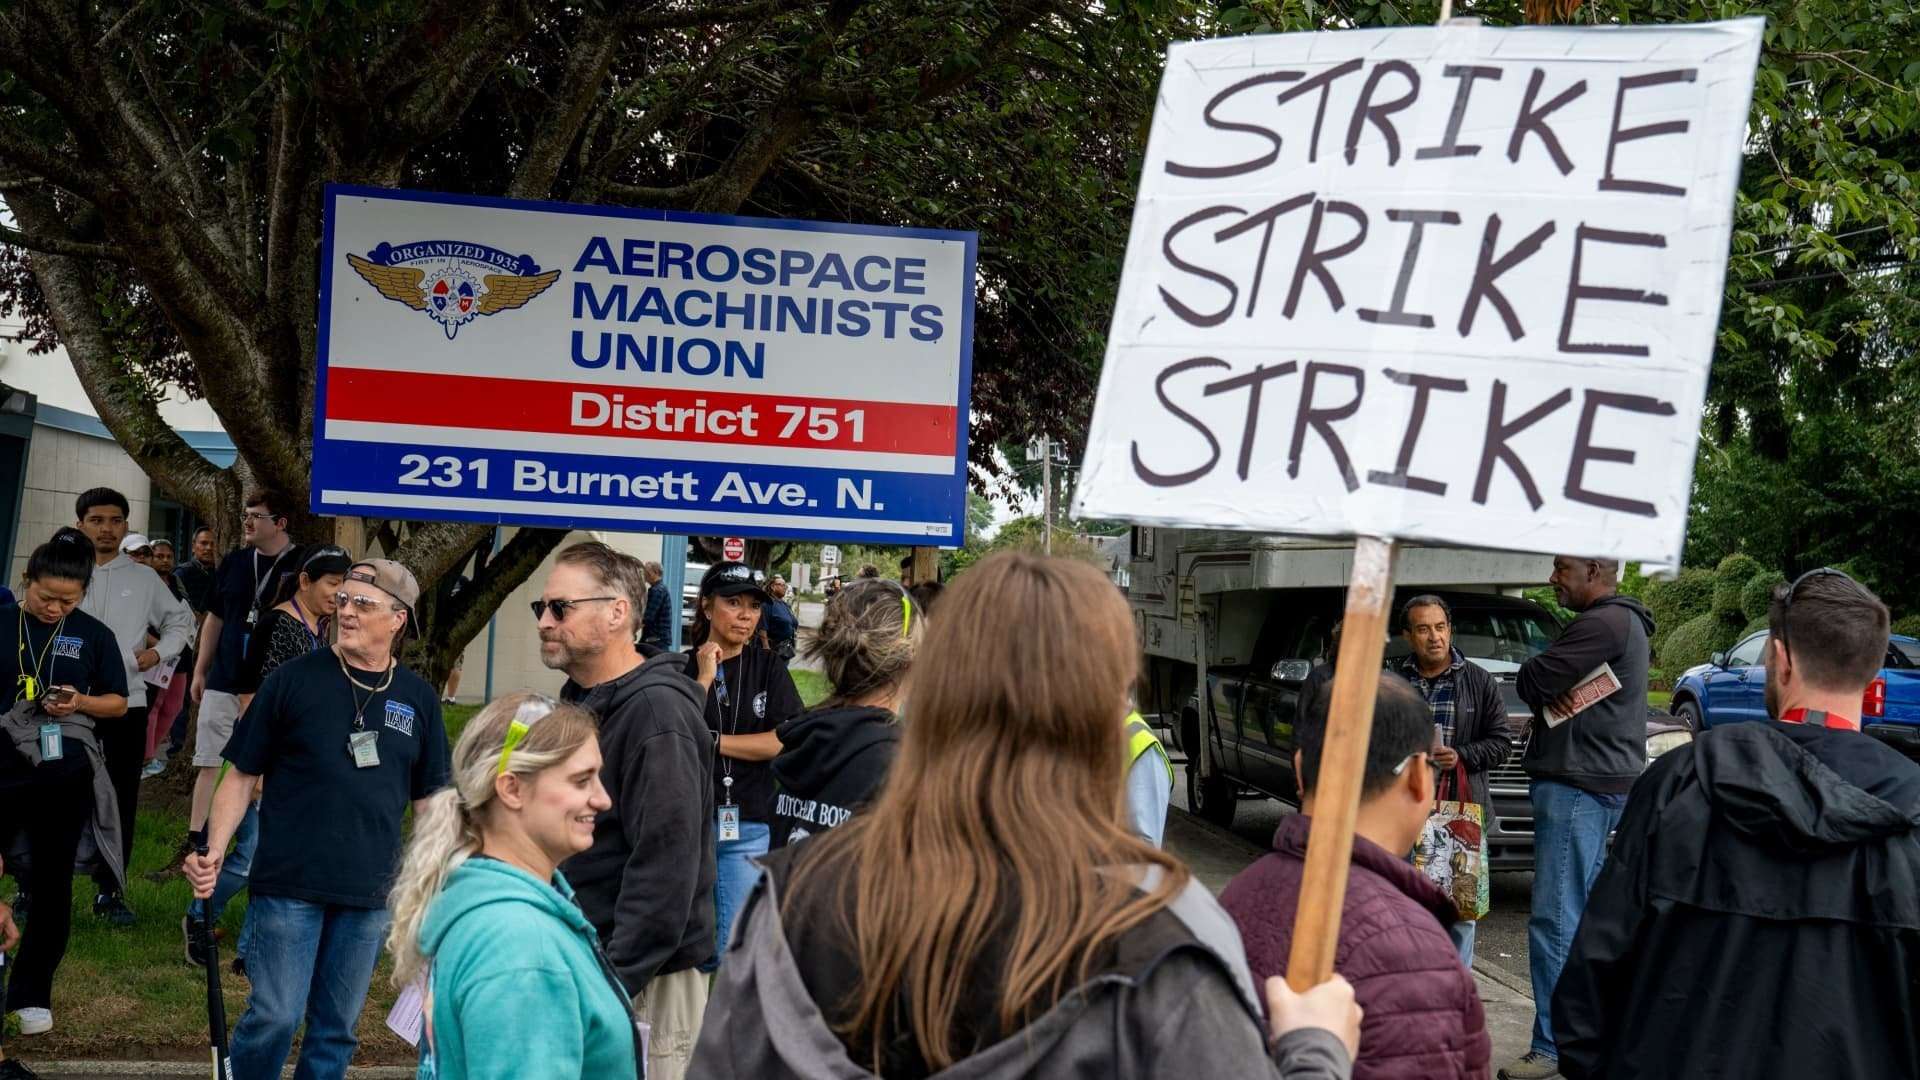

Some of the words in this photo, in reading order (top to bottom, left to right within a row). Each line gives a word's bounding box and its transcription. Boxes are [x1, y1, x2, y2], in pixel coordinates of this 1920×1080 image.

[1165, 58, 1697, 196] STRIKE
[390, 244, 485, 262] ORGANIZED
[489, 252, 520, 271] 1935
[571, 236, 927, 296] AEROSPACE
[1159, 192, 1668, 356] STRIKE
[570, 281, 944, 344] MACHINISTS
[570, 330, 766, 379] UNION
[571, 391, 759, 437] District
[775, 405, 865, 443] 751
[1132, 357, 1677, 518] STRIKE
[398, 454, 489, 489] 231
[513, 459, 699, 501] Burnett
[710, 471, 818, 508] Ave.
[836, 477, 884, 511] N.
